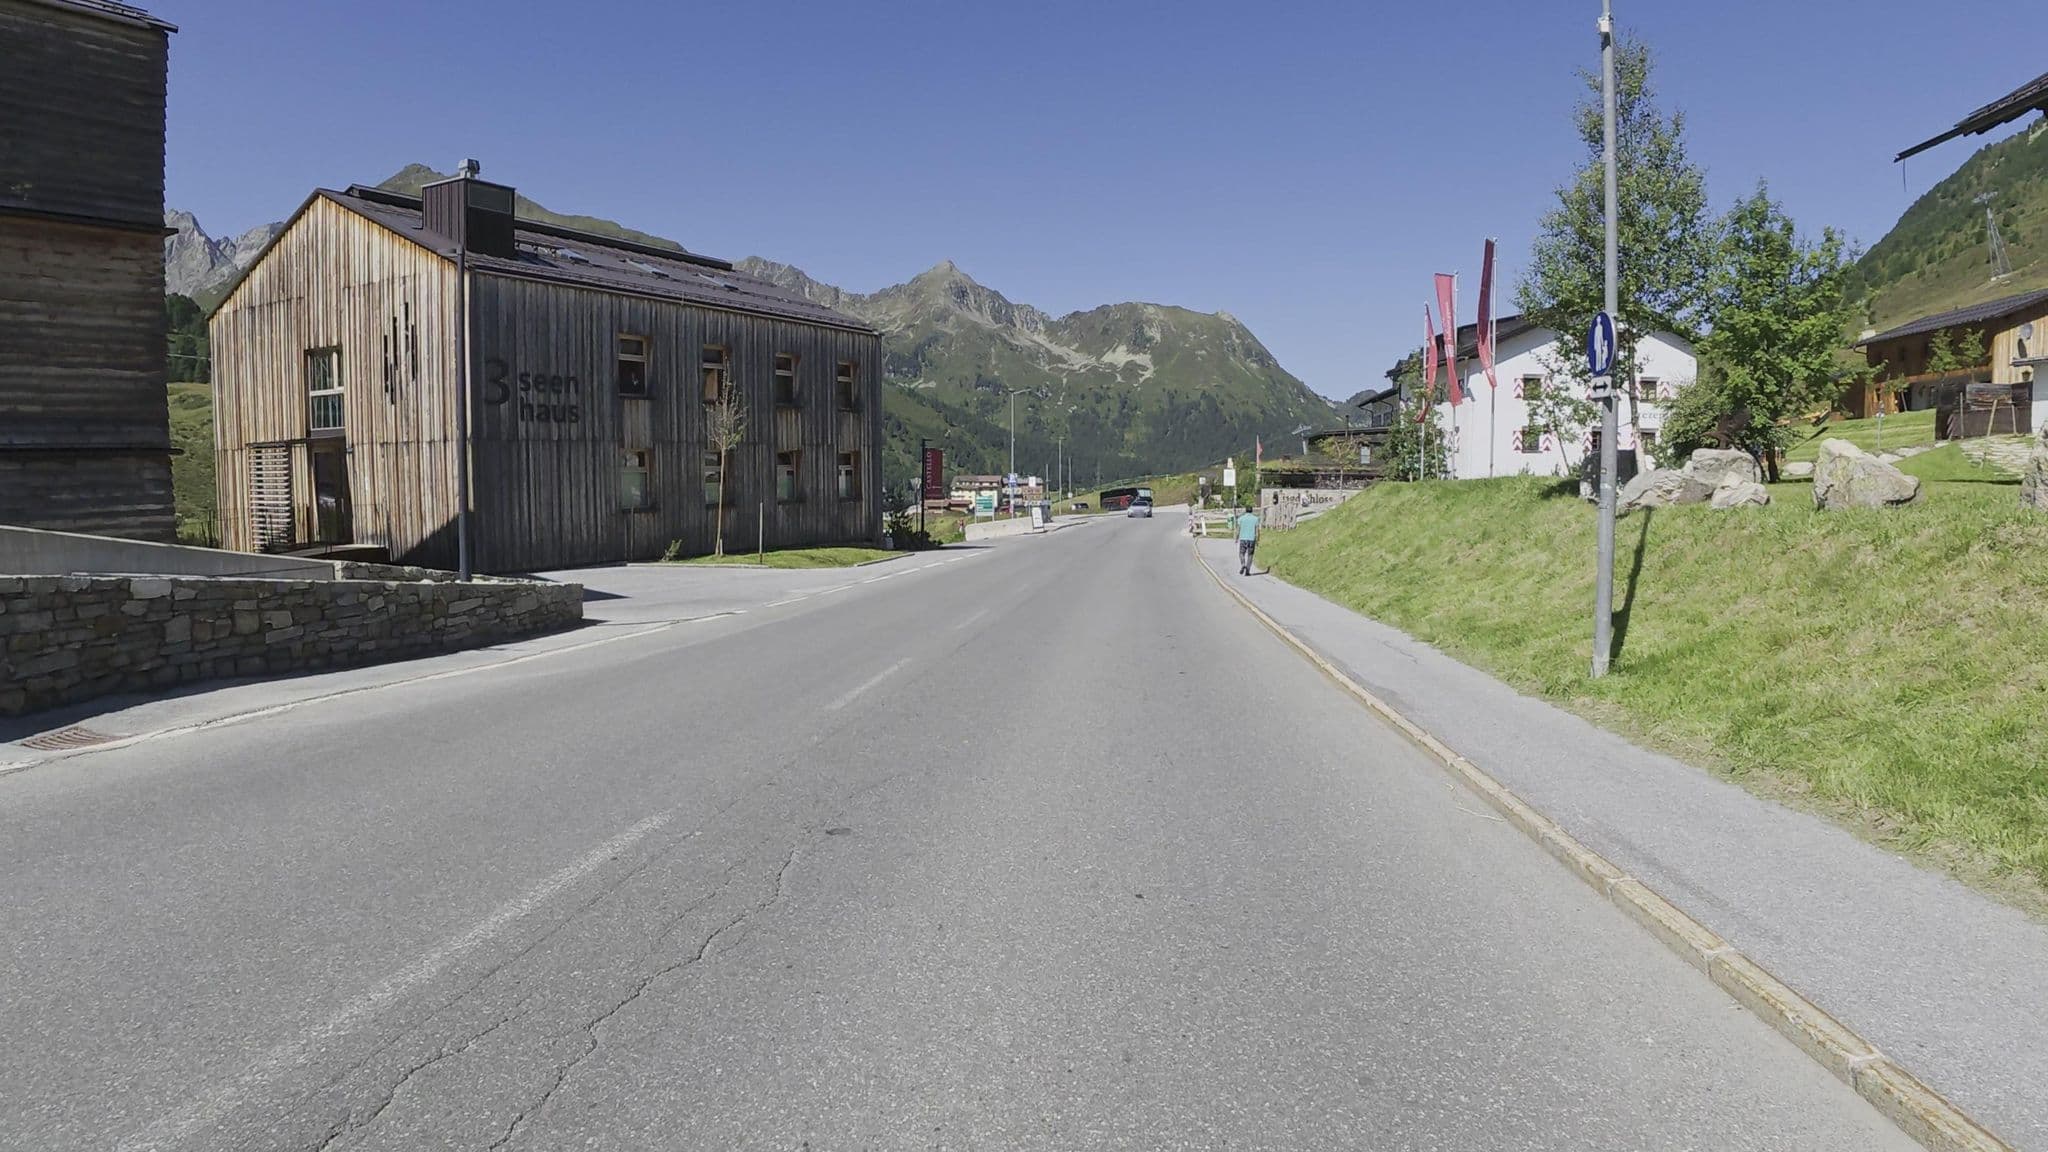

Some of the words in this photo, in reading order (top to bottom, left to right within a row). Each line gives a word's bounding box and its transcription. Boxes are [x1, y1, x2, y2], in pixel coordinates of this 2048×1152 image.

[485, 358, 511, 405] 3
[518, 373, 579, 395] seen
[518, 397, 580, 423] haus
